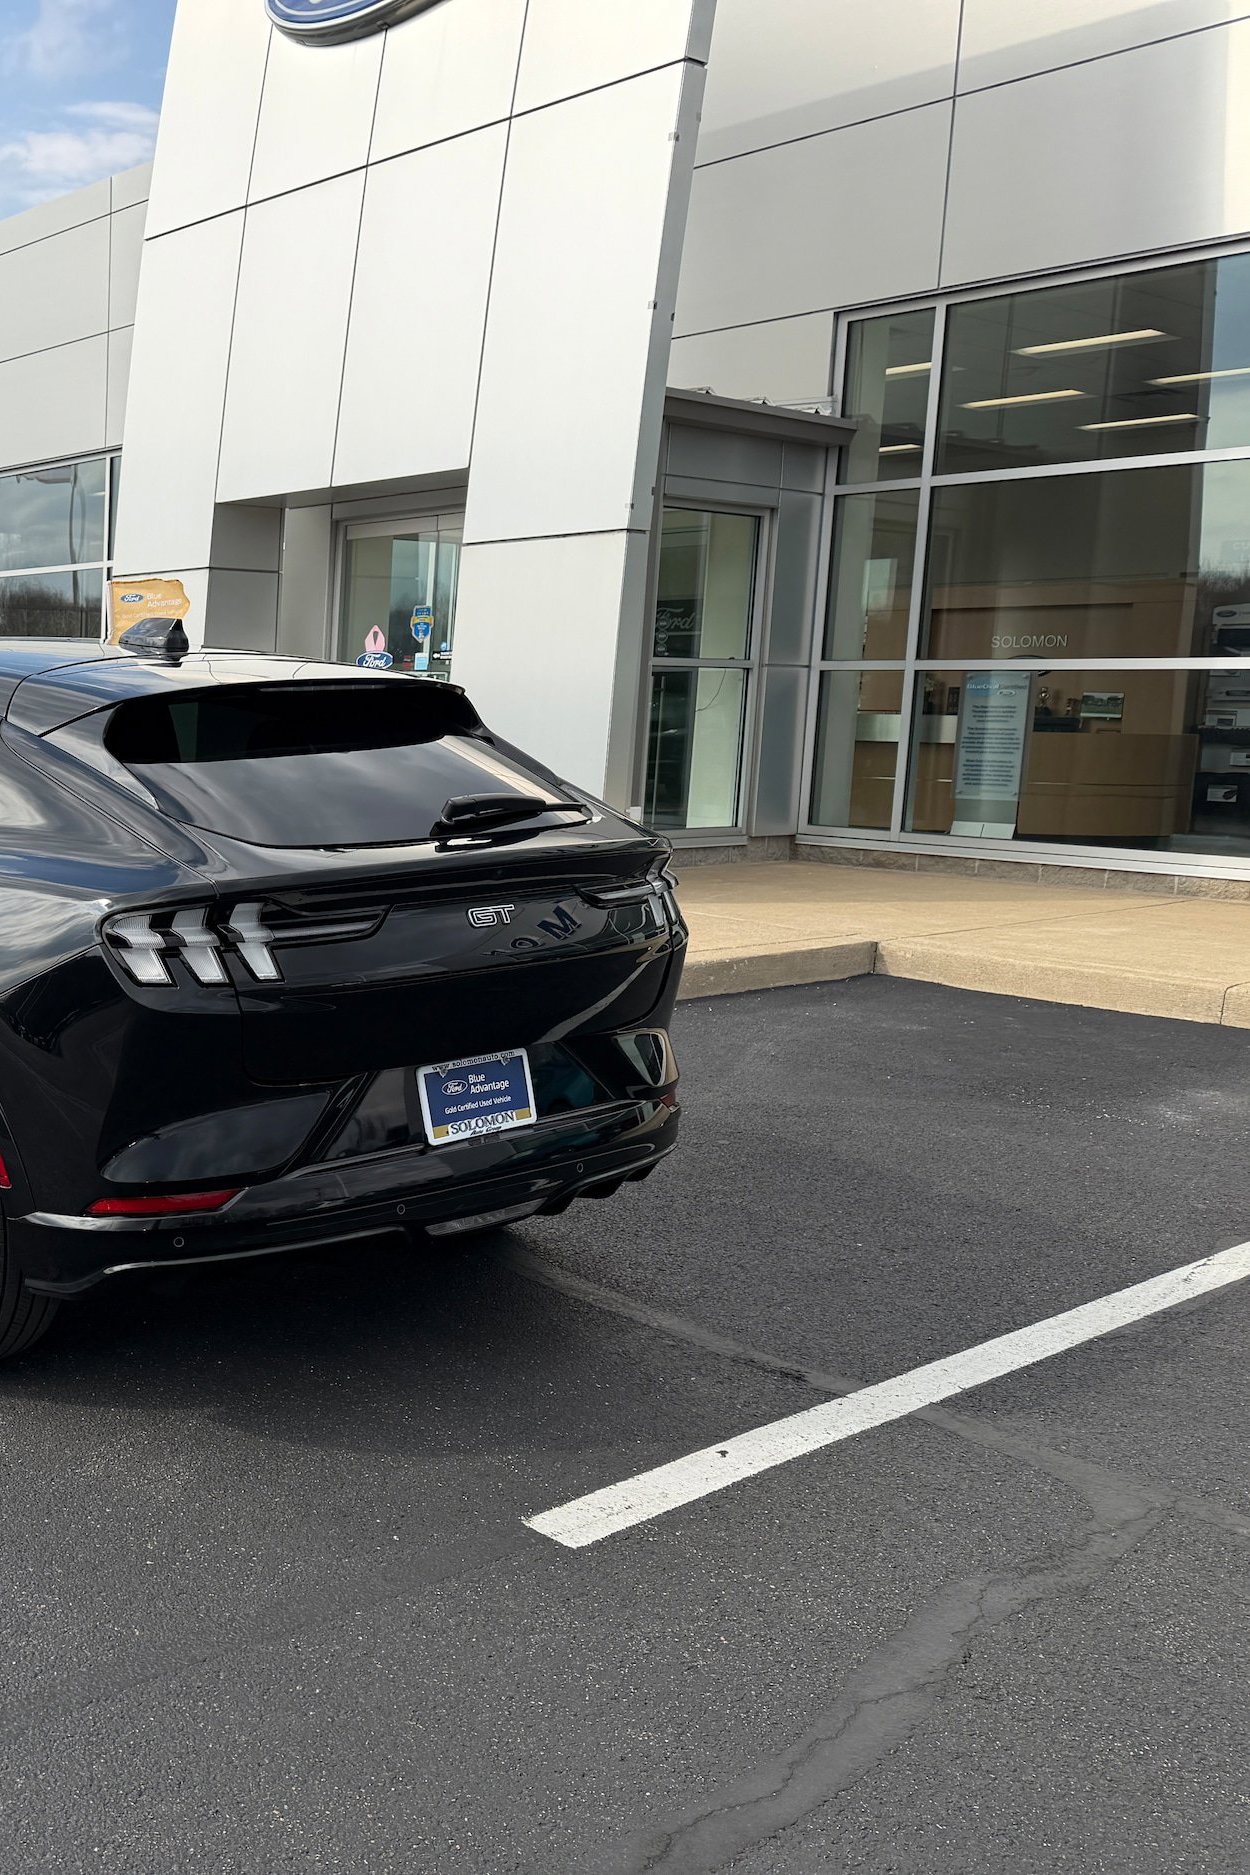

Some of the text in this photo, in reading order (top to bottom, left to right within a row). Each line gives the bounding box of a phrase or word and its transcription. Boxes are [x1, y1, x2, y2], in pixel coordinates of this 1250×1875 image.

[990, 634, 1068, 649] SOLOMON
[362, 653, 386, 668] Ford
[468, 904, 515, 928] GT
[468, 1073, 486, 1084] Blue
[470, 1080, 510, 1095] Advantage
[444, 1095, 512, 1115] Gold Certified Used Vehicle
[450, 1111, 516, 1135] SOLOMON
